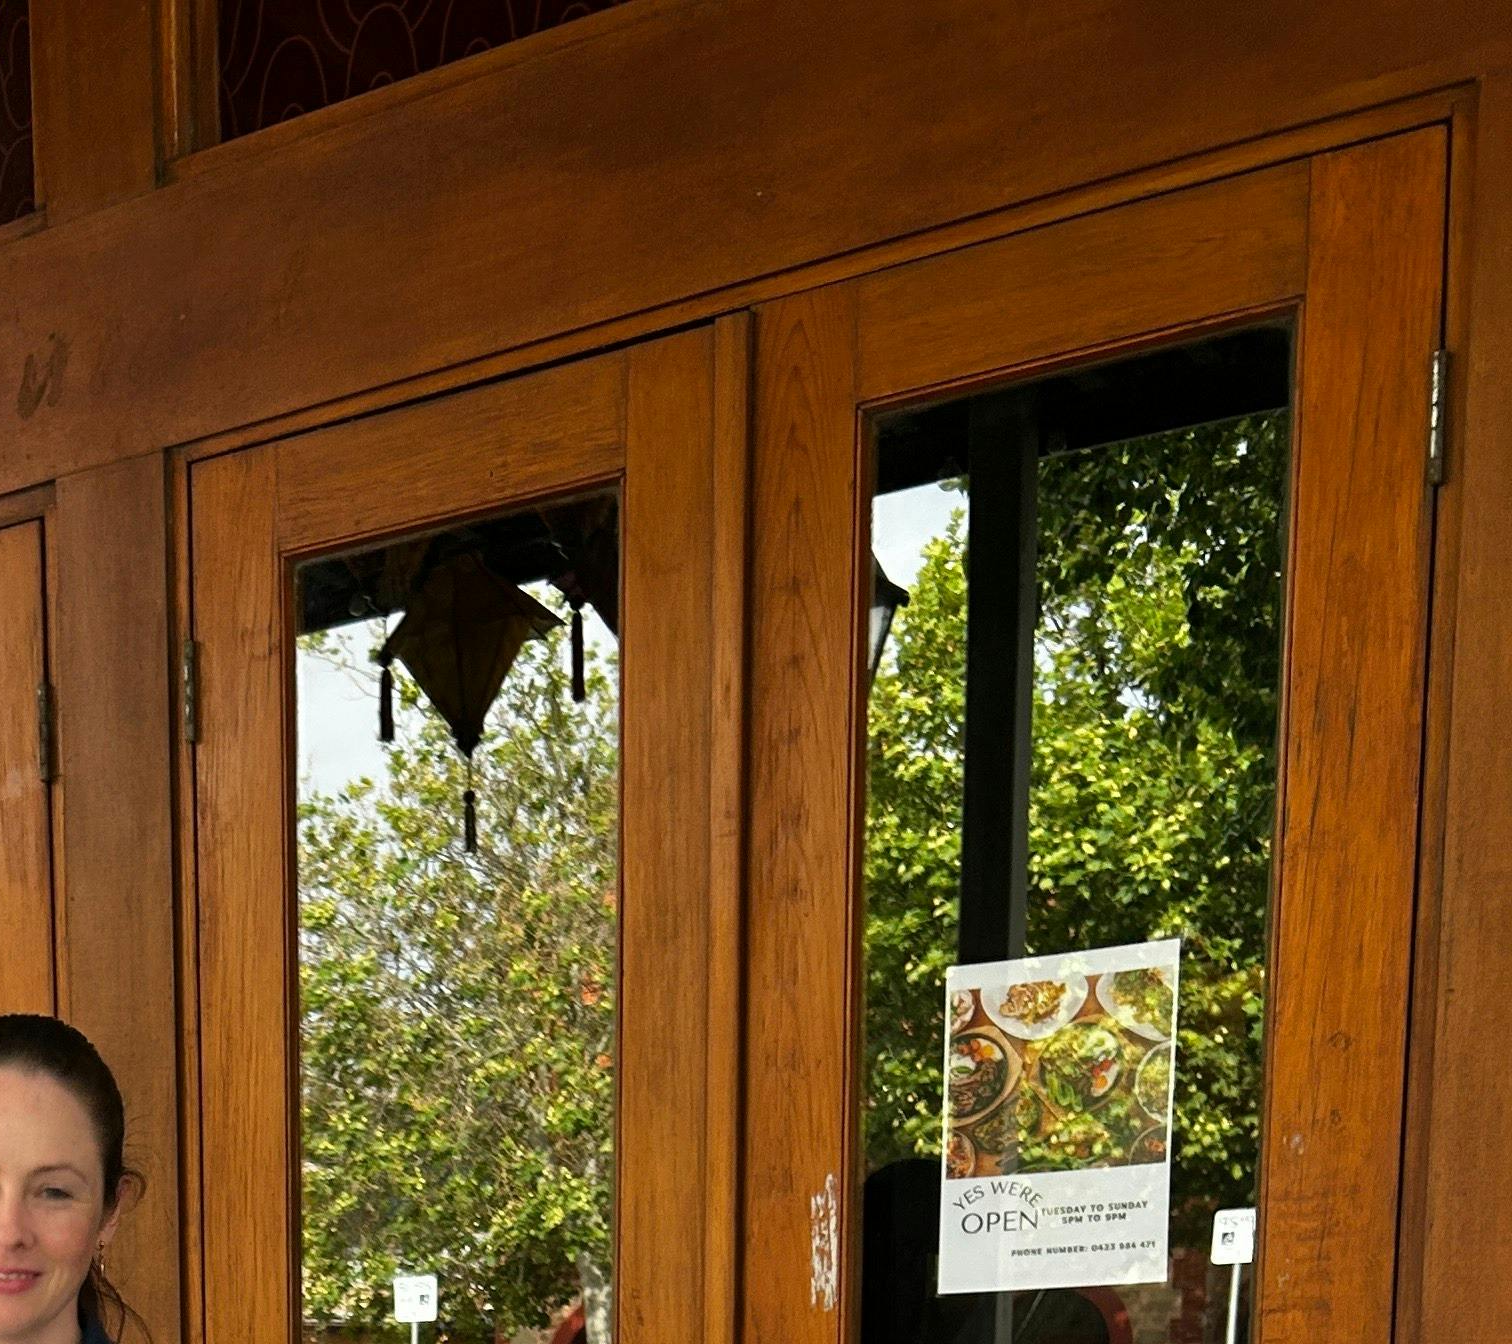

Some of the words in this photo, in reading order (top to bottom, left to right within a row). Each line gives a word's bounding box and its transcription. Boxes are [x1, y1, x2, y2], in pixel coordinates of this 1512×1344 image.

[952, 1185, 985, 1211] YES
[990, 1180, 1043, 1208] WE'RE
[1041, 1205, 1087, 1216] TUESDAY
[1091, 1204, 1104, 1213] TO
[1108, 1200, 1148, 1211] SUNDAY
[961, 1210, 1039, 1235] OPEN
[1062, 1216, 1084, 1225] 5PM
[1088, 1214, 1101, 1223] TO
[1011, 1247, 1042, 1257] PHONE
